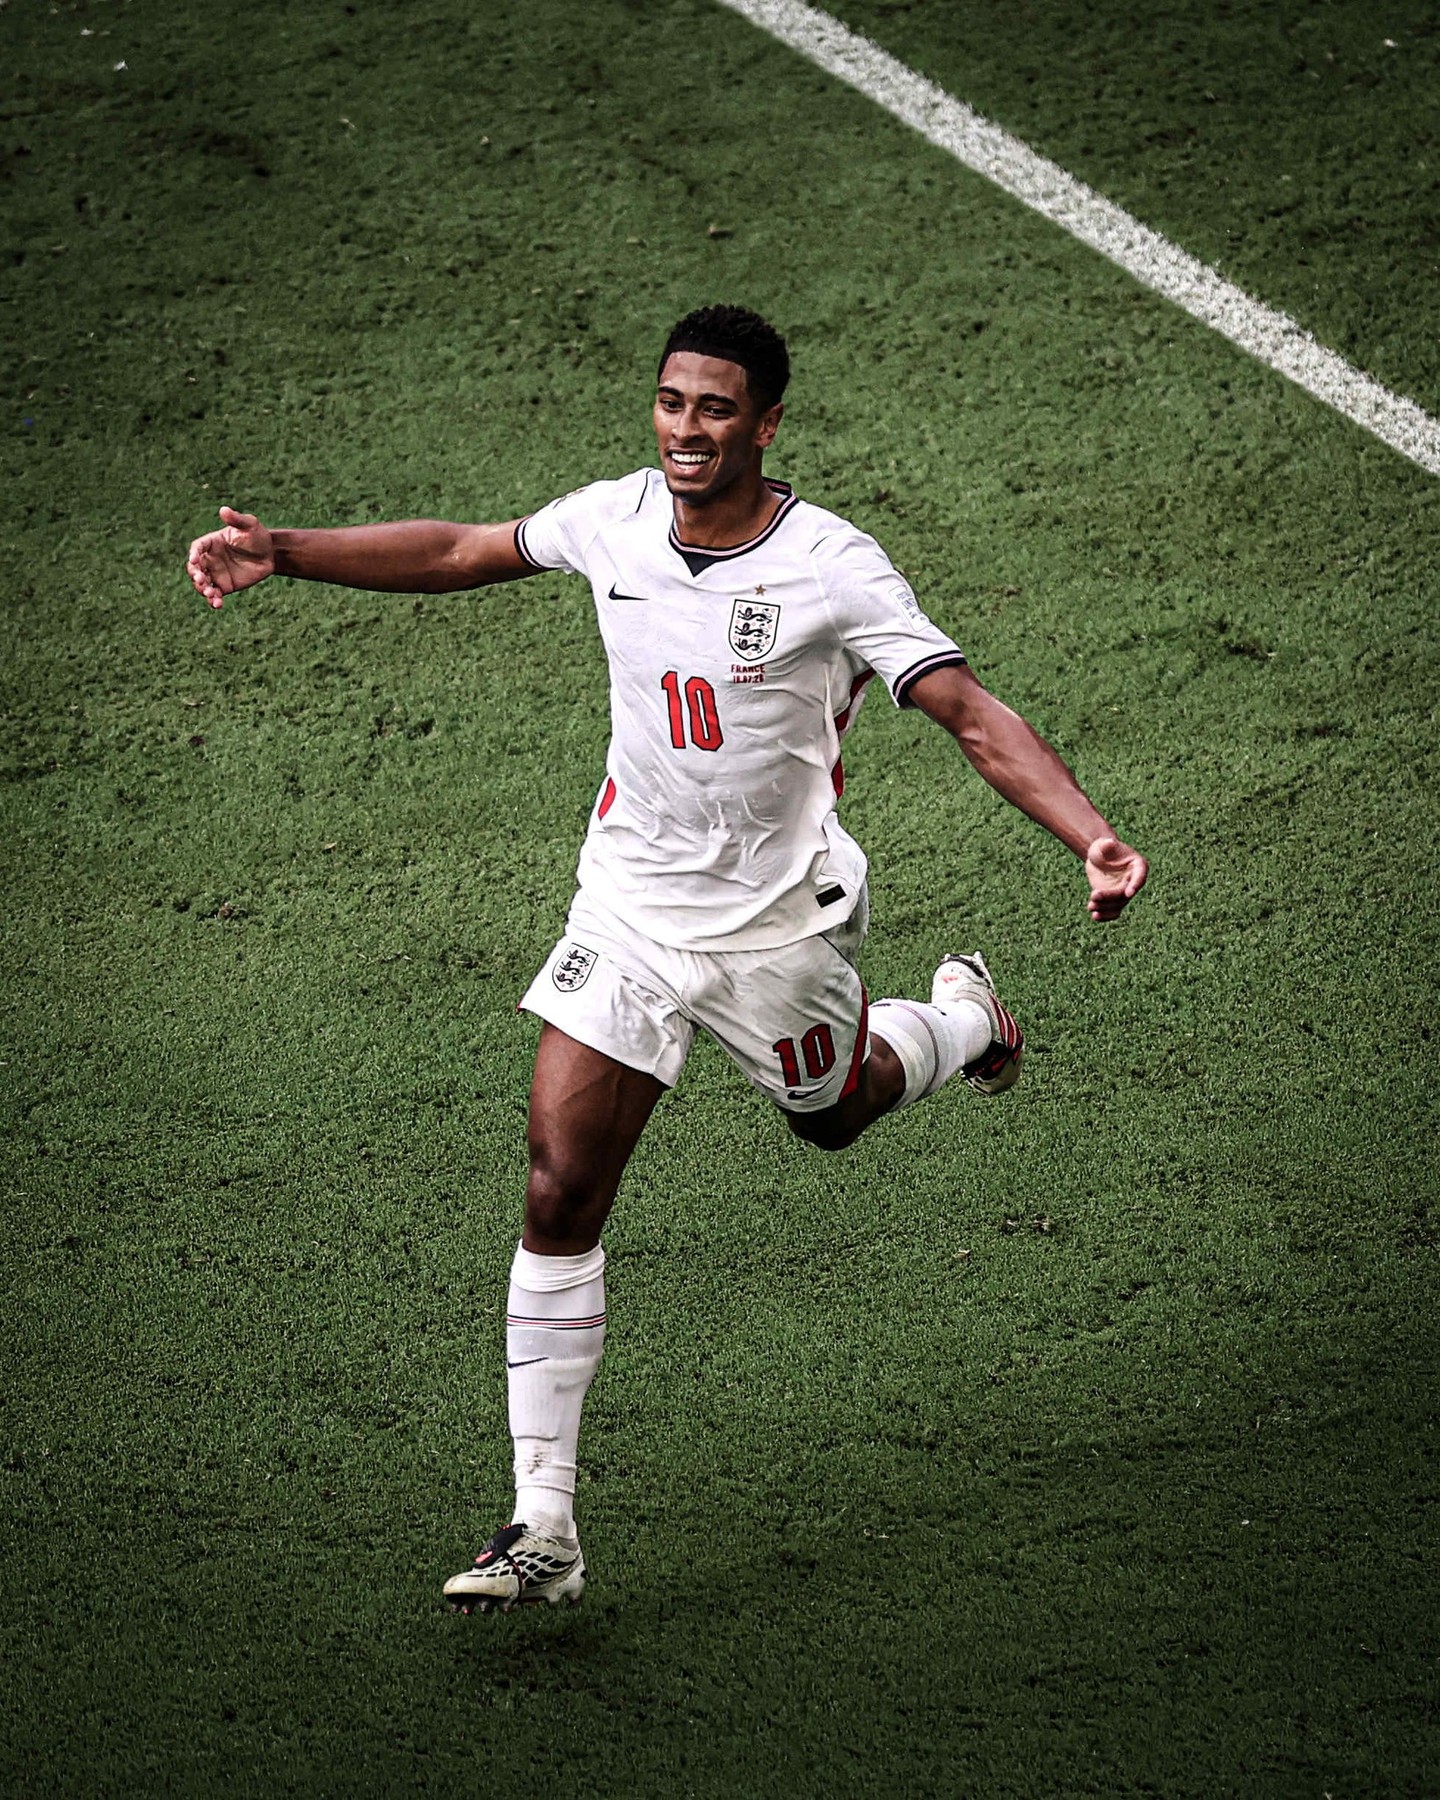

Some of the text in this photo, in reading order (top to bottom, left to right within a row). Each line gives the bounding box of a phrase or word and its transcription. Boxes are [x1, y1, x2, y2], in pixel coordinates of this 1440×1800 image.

[731, 664, 766, 673] FRANCE
[661, 670, 724, 752] 10
[772, 1023, 836, 1088] 10
